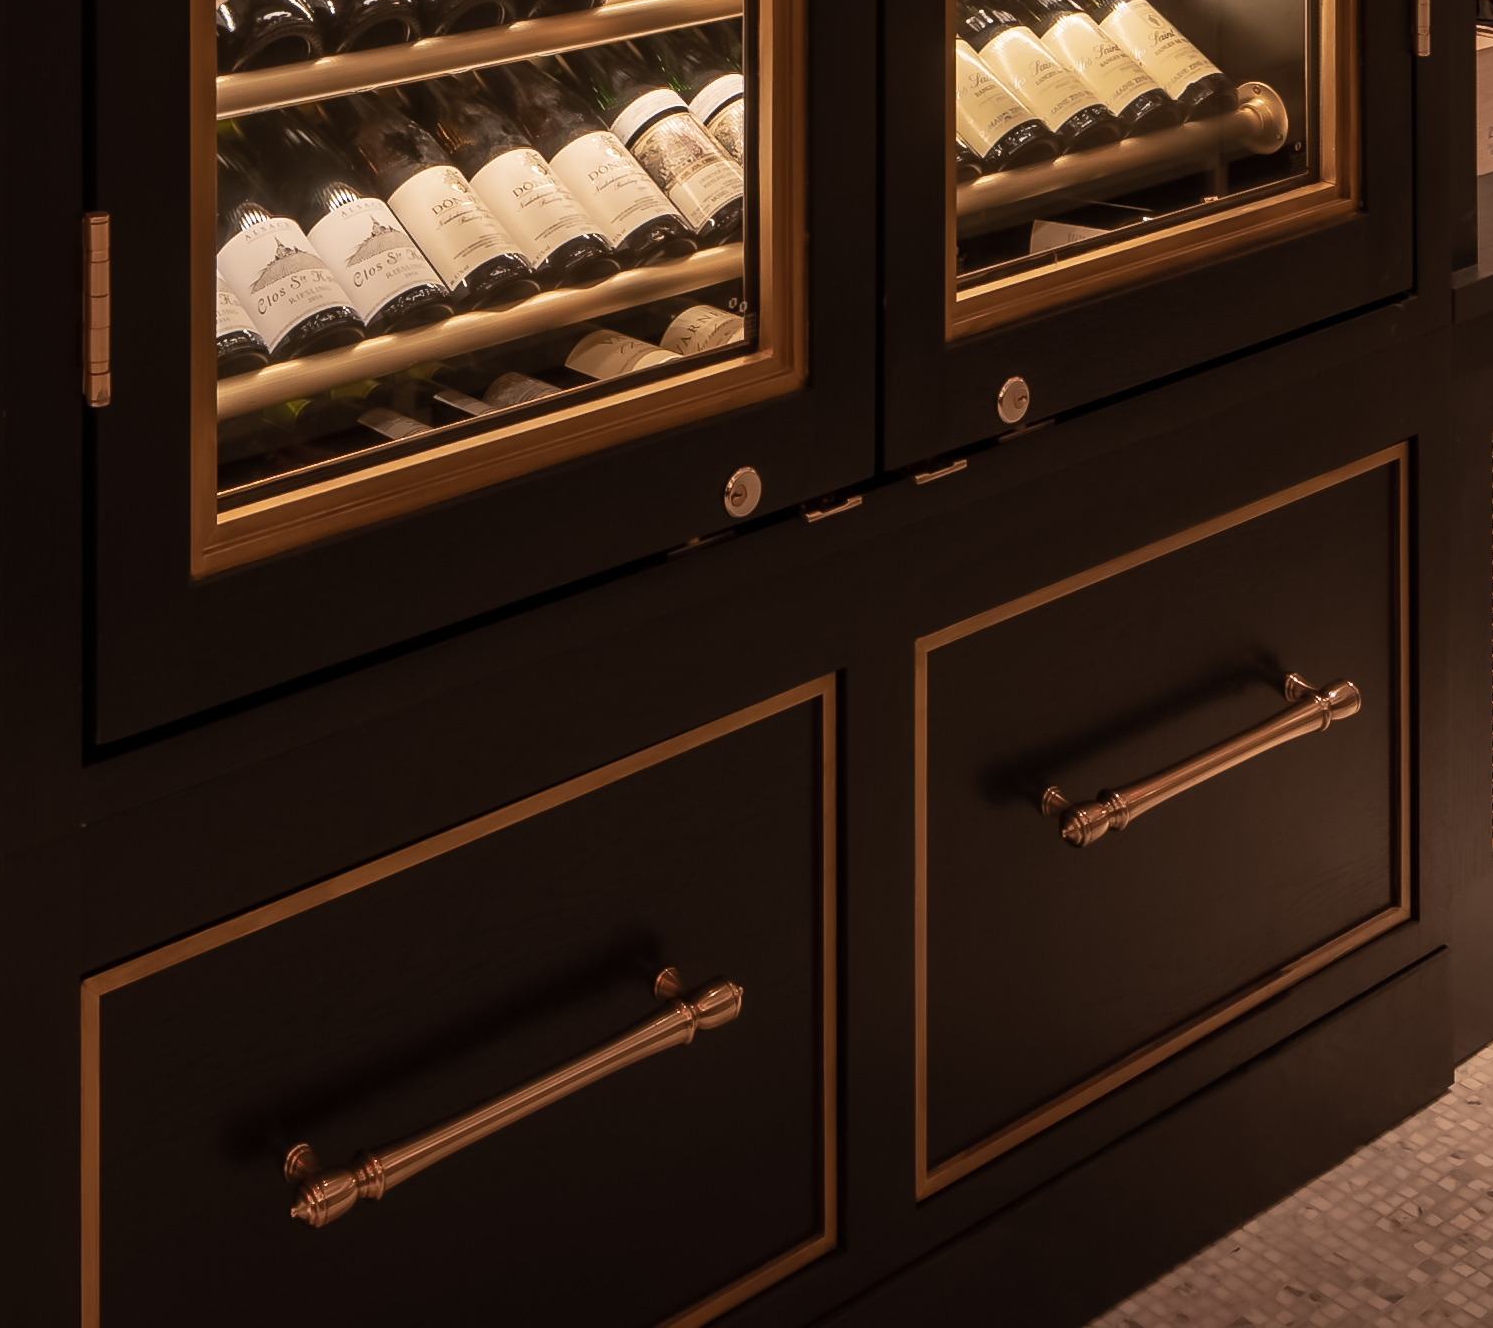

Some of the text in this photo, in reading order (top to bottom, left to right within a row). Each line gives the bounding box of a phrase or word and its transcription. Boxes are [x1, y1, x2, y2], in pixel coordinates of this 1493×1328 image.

[245, 220, 292, 241] ALSACE
[353, 263, 384, 289] Clos
[385, 262, 426, 280] RIESLING
[257, 285, 287, 315] Clos
[289, 284, 332, 305] RIESLING
